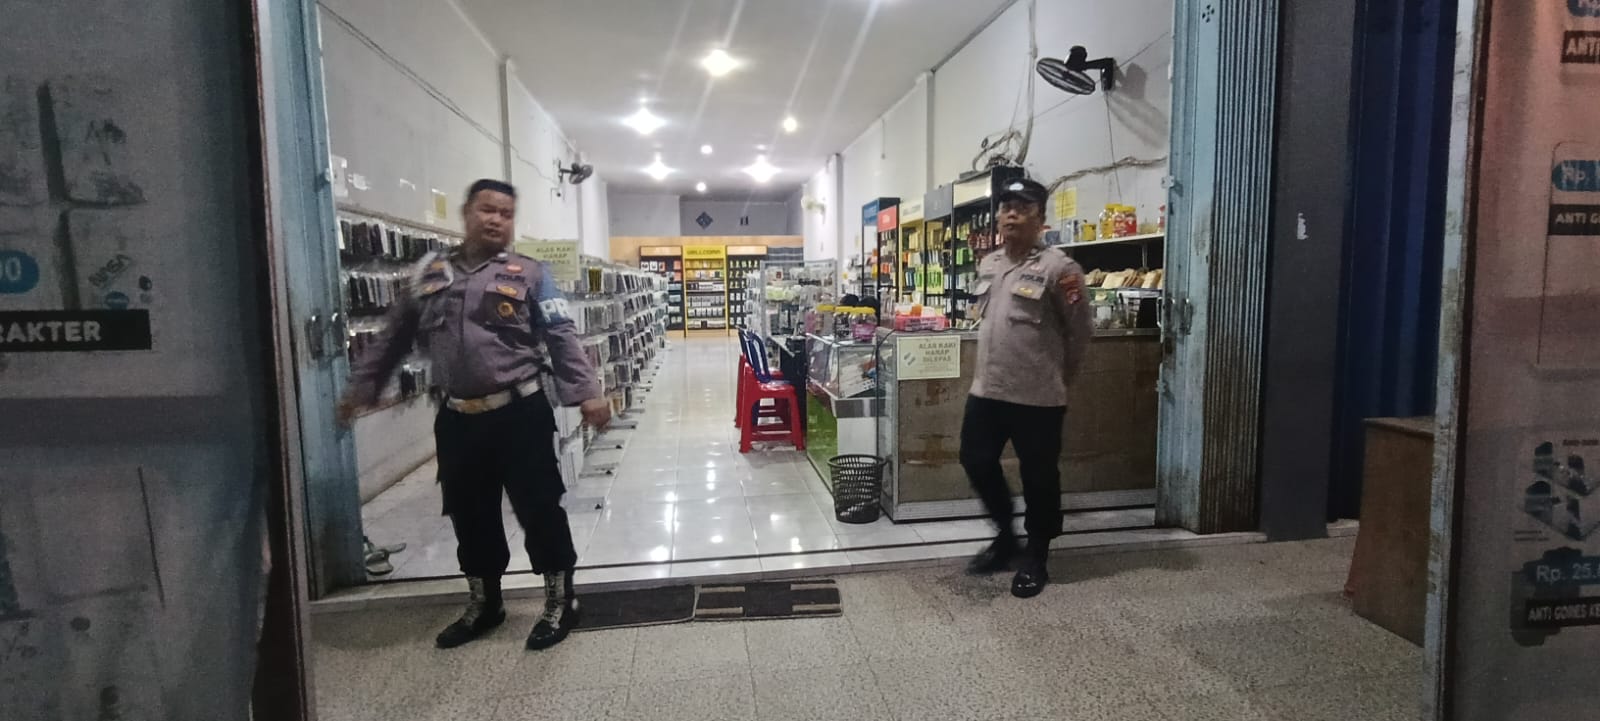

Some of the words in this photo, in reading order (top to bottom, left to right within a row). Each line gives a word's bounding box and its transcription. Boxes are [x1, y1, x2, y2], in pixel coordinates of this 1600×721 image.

[1555, 212, 1586, 225] ANTI
[0, 320, 102, 343] AKTER
[1572, 562, 1600, 580] 25.
[1528, 606, 1552, 622] ANTI
